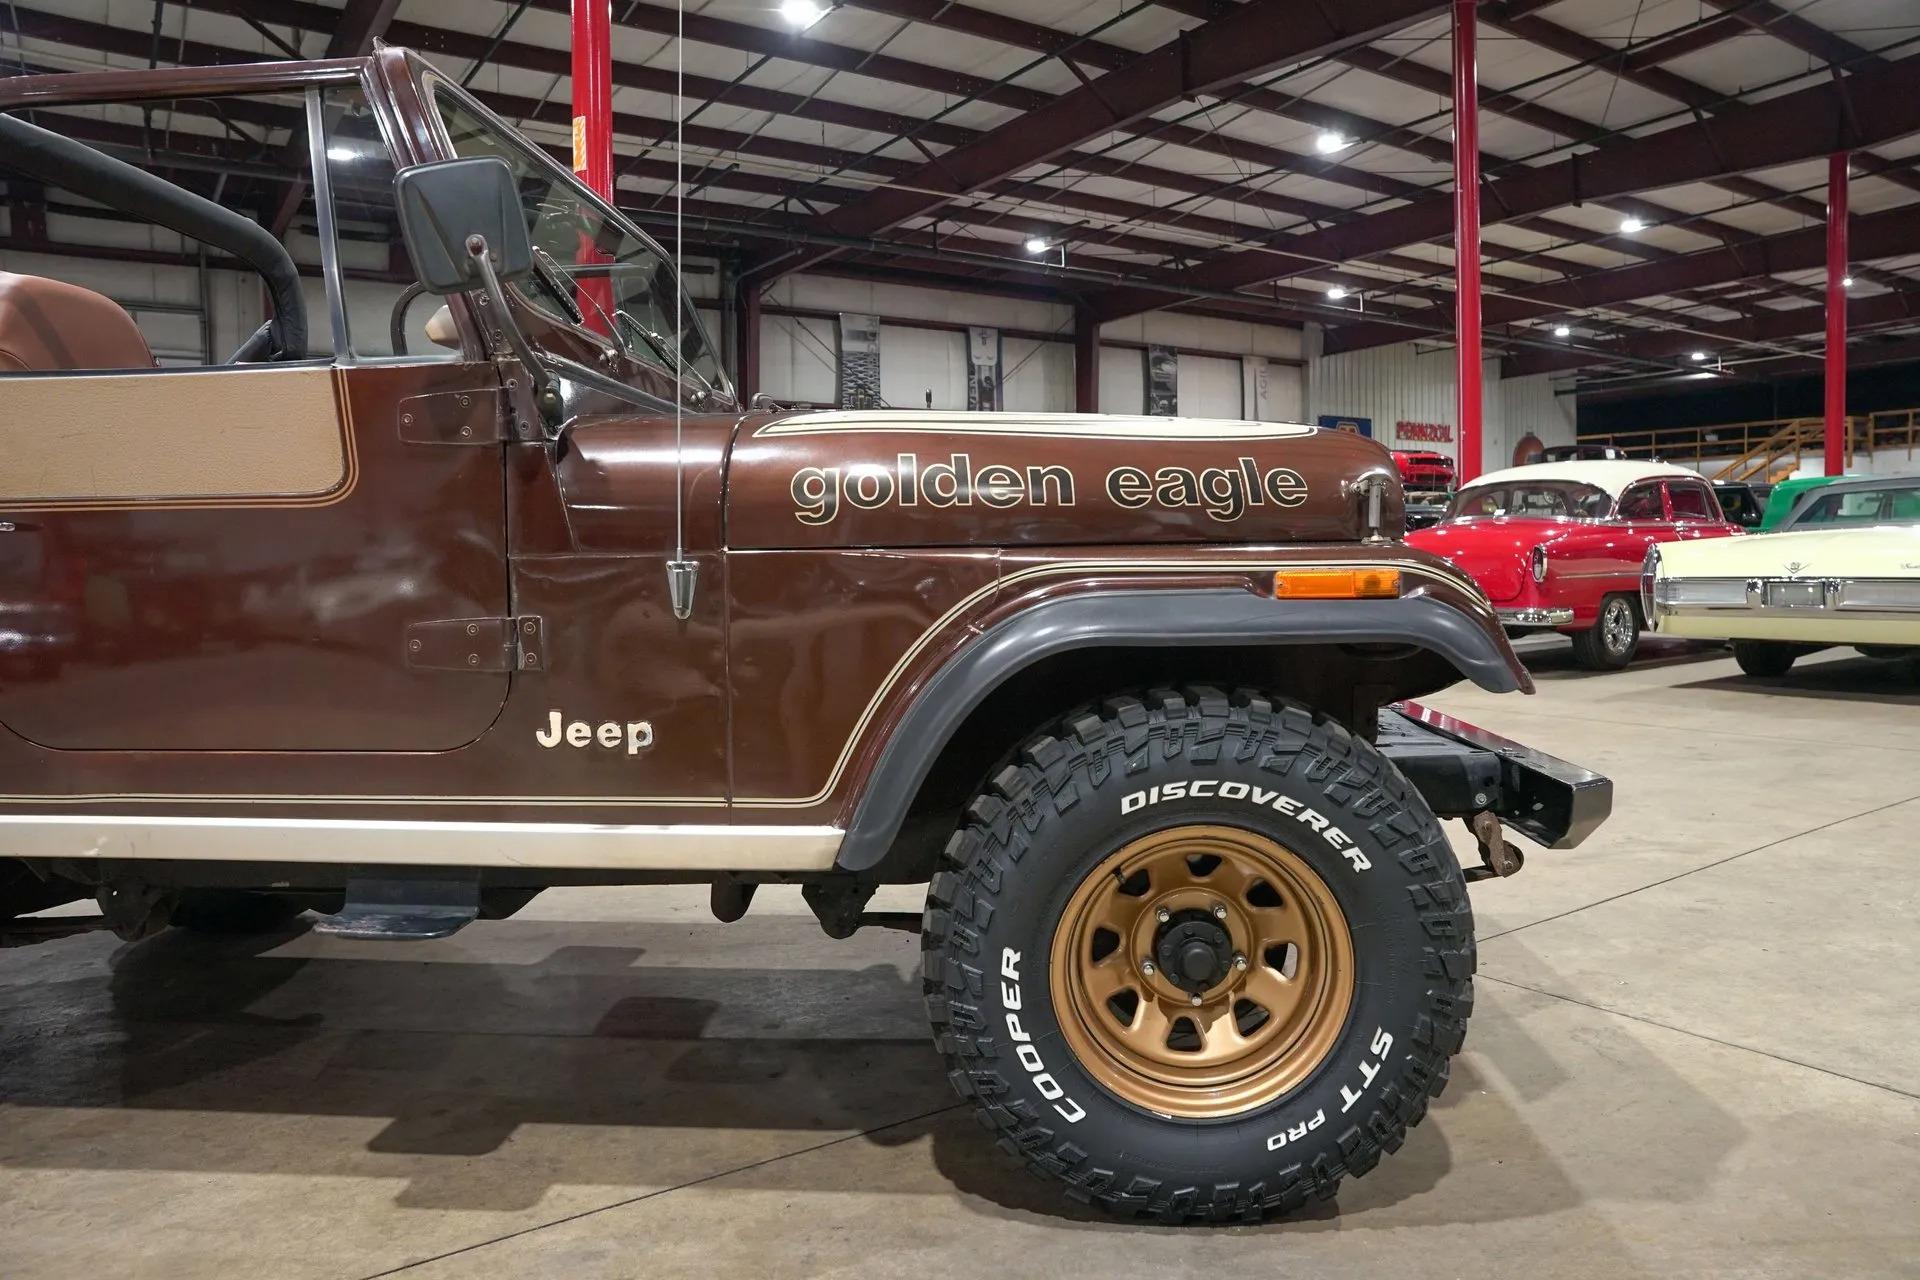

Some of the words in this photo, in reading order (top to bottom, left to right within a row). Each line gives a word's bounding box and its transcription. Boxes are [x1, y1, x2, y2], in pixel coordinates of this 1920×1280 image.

[790, 453, 1076, 526] golden
[1105, 457, 1309, 522] eagle
[535, 711, 653, 755] Jeep
[1120, 780, 1372, 873] DISCOVERER
[1001, 946, 1087, 1123] COOPER
[1340, 1026, 1394, 1114] STT
[1266, 1108, 1327, 1152] PRO
